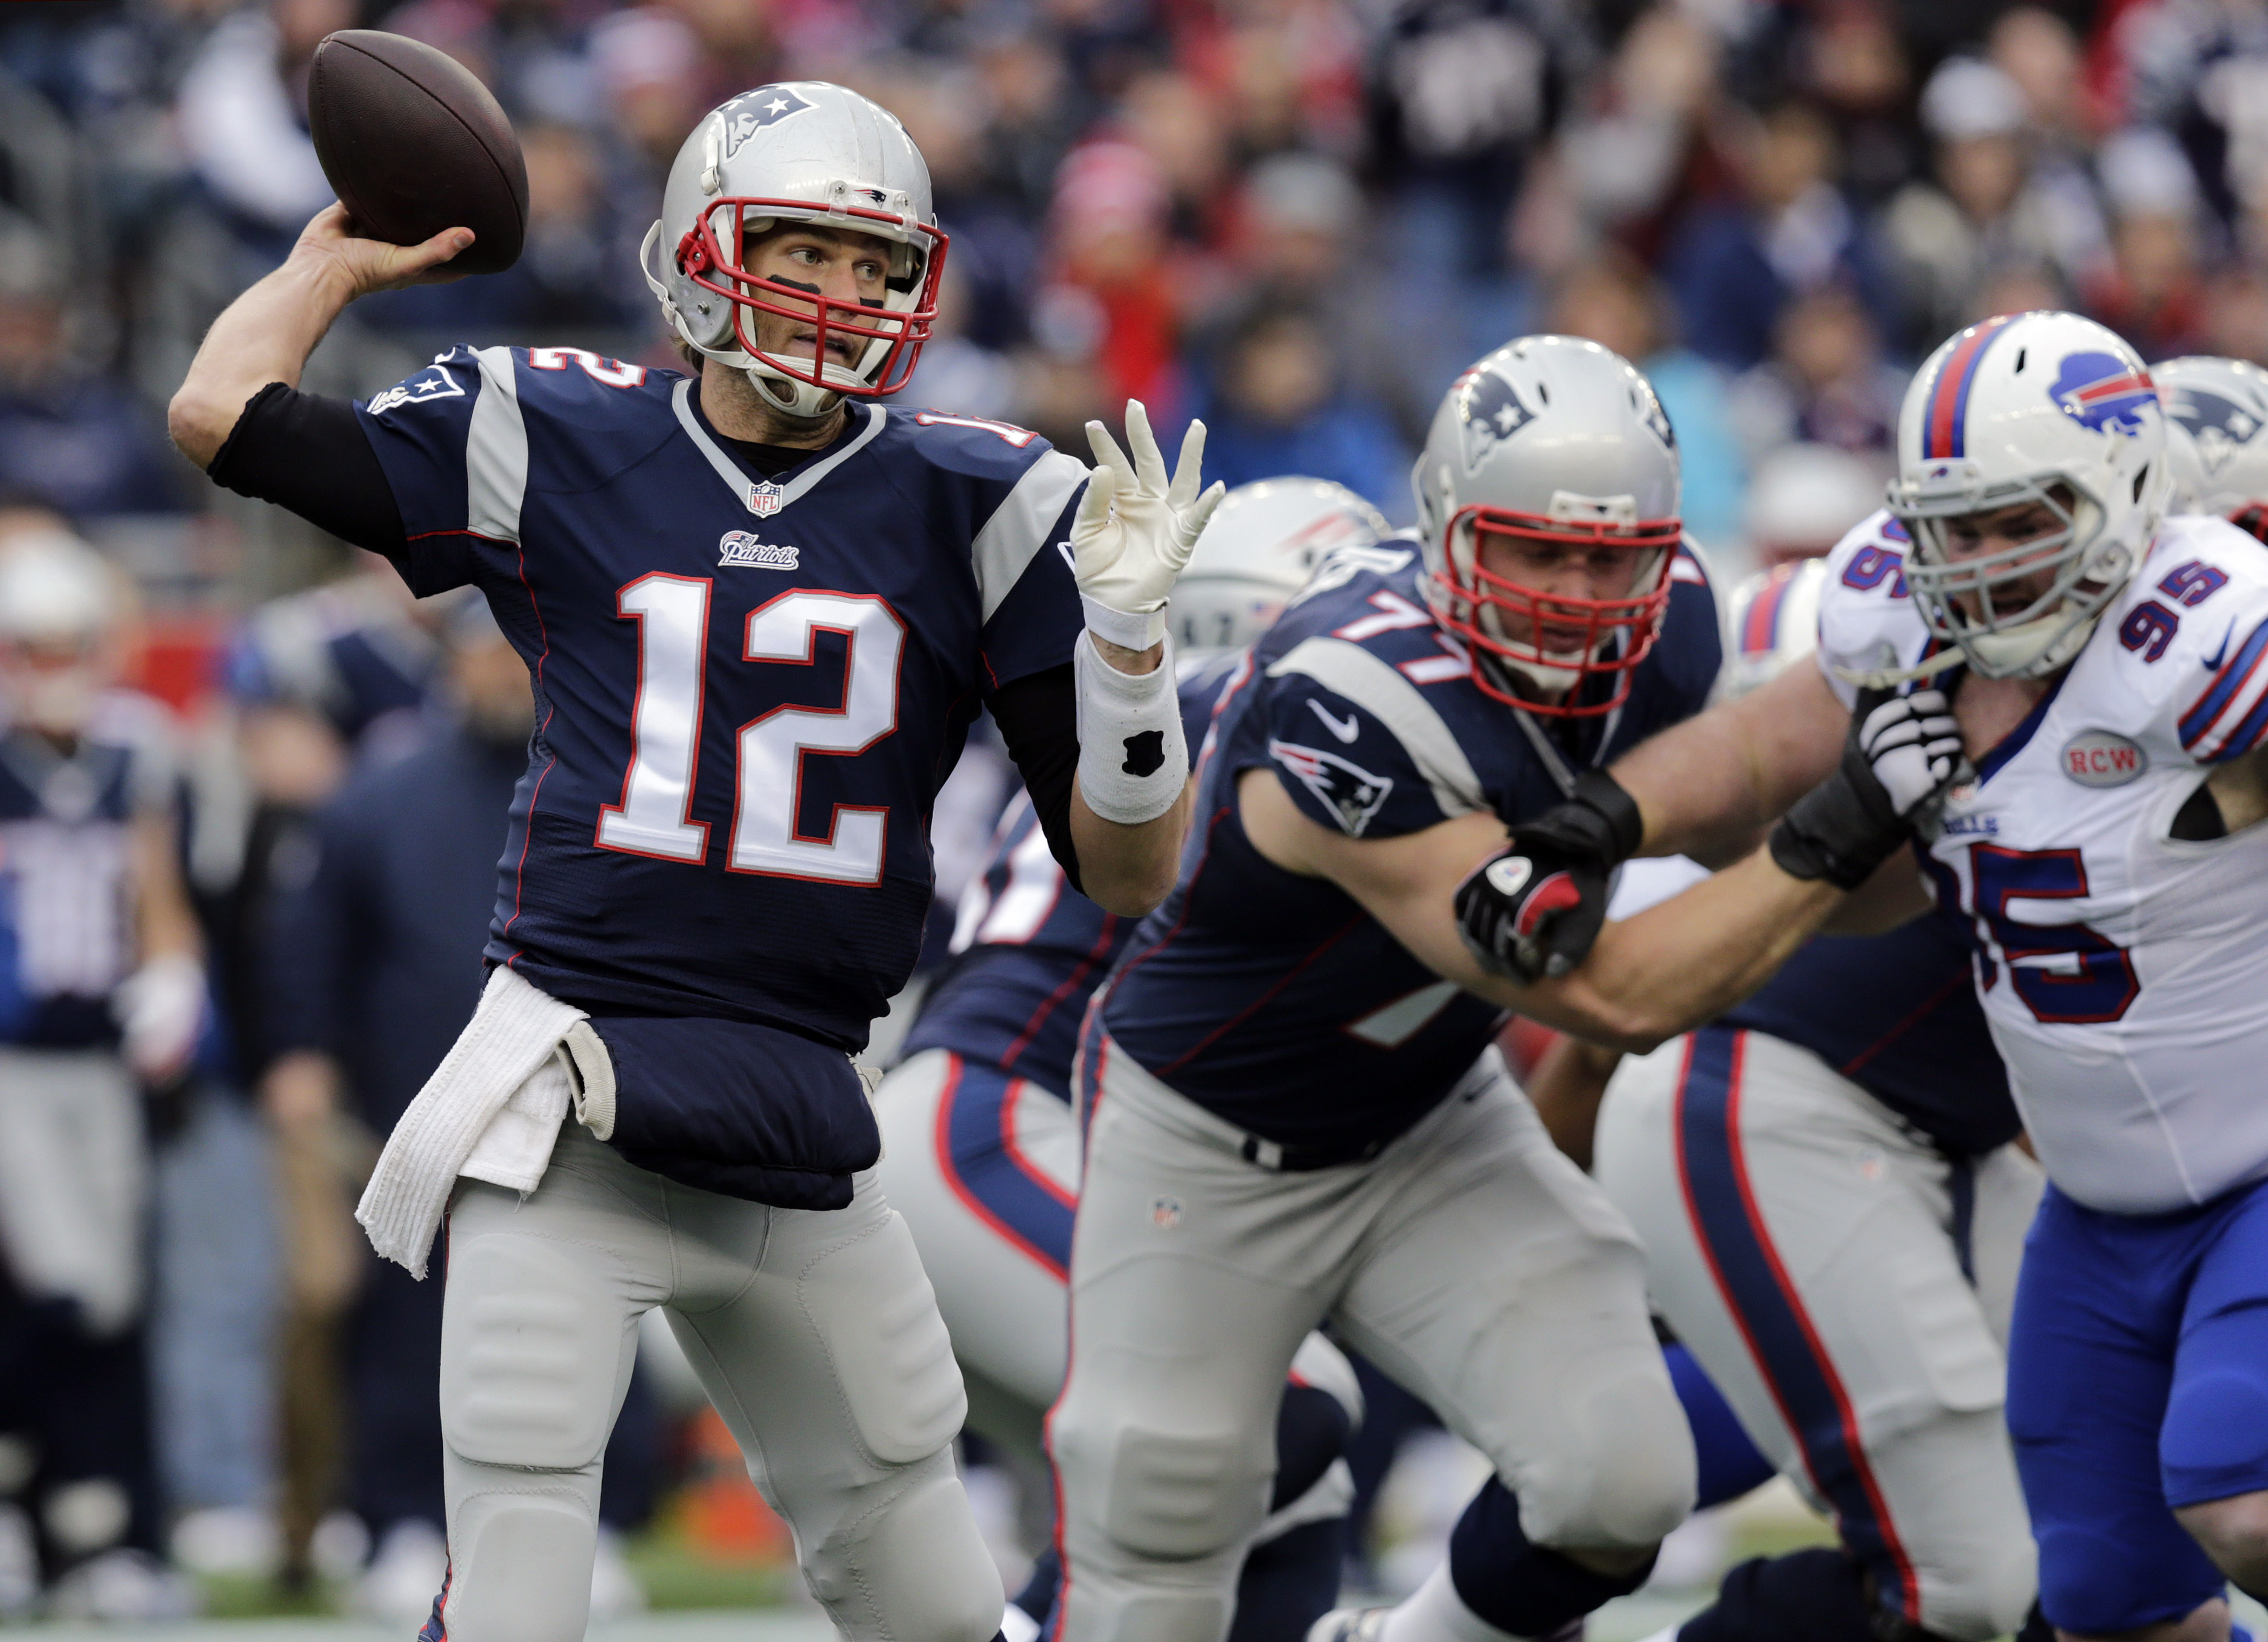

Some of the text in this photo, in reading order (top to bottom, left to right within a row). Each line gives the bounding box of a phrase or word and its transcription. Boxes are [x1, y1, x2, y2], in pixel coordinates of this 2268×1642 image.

[914, 407, 1041, 449] 1
[752, 495, 777, 511] NFL
[721, 539, 798, 567] Patriots
[2119, 561, 2229, 664] 95
[593, 570, 910, 889] 12
[2069, 747, 2136, 774] RCW
